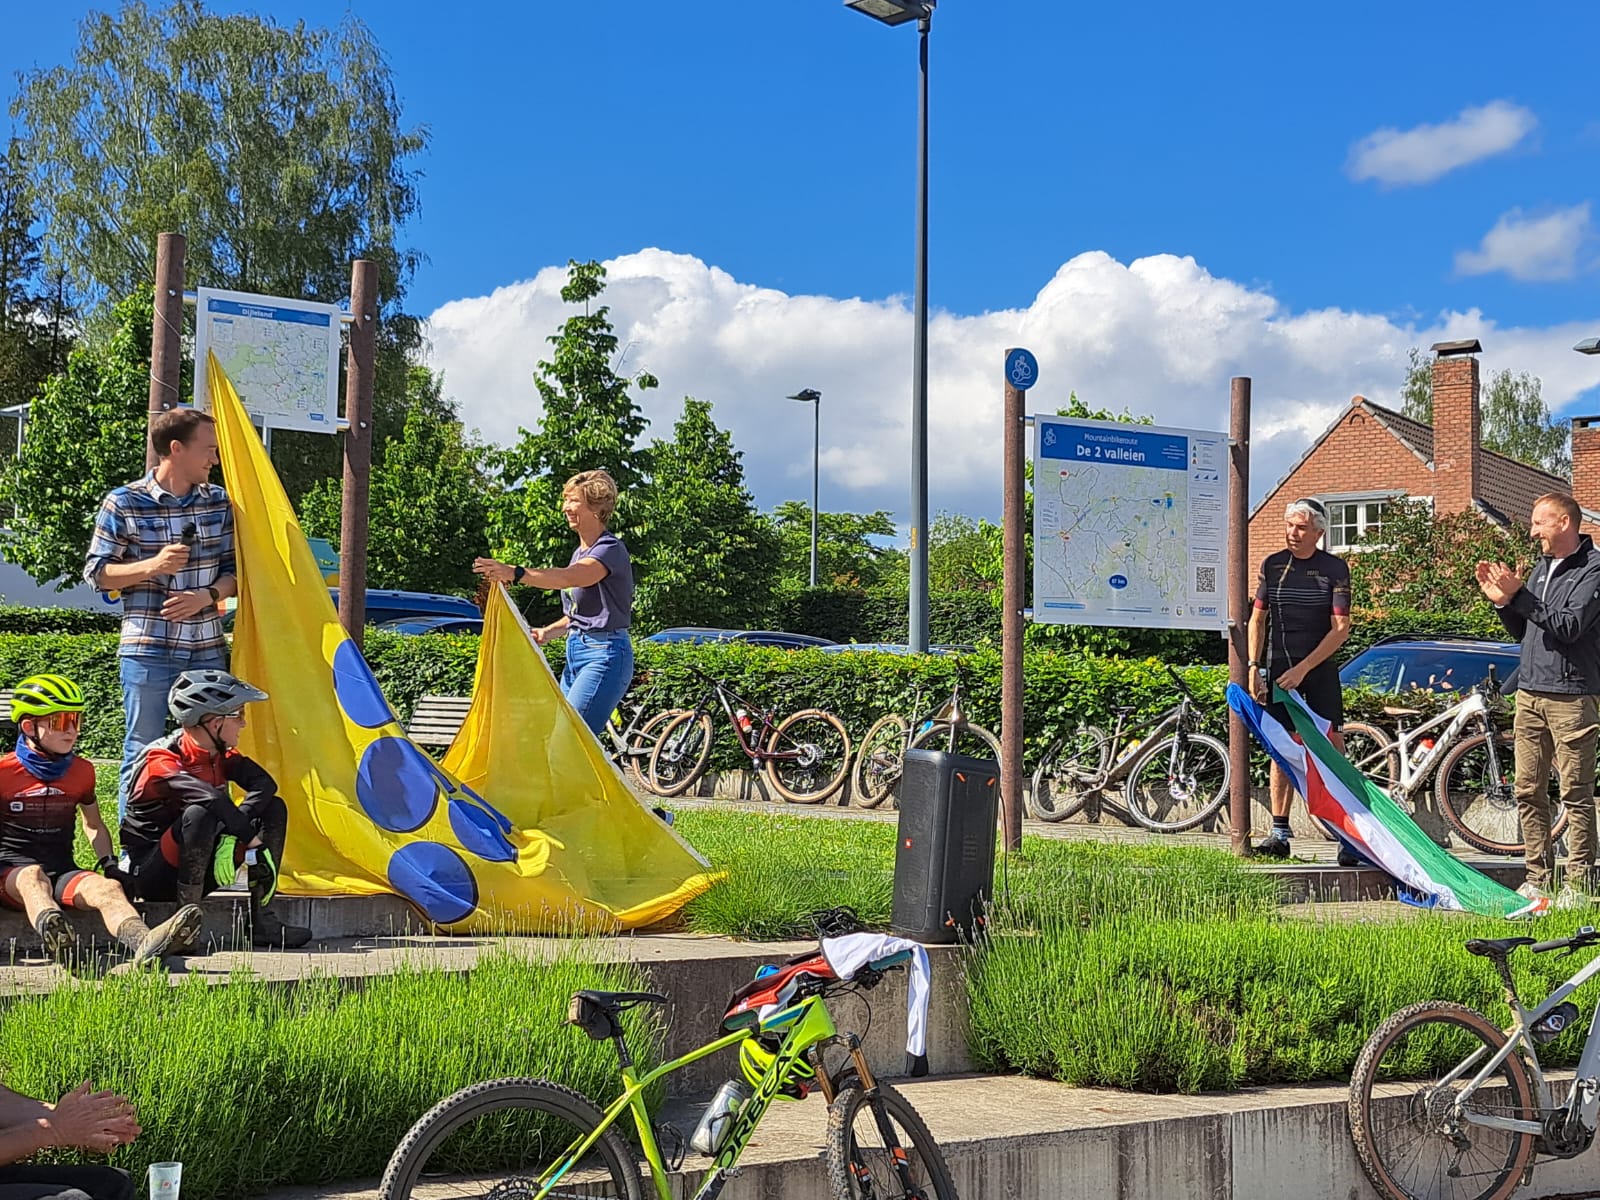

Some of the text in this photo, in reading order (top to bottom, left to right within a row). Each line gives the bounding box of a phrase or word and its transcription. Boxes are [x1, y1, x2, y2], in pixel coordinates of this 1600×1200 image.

[1084, 432, 1138, 445] Mountainbikeroute
[1077, 444, 1091, 457] De
[1094, 446, 1101, 458] 2
[1104, 448, 1145, 462] valleien
[720, 1056, 792, 1169] ORBEA
